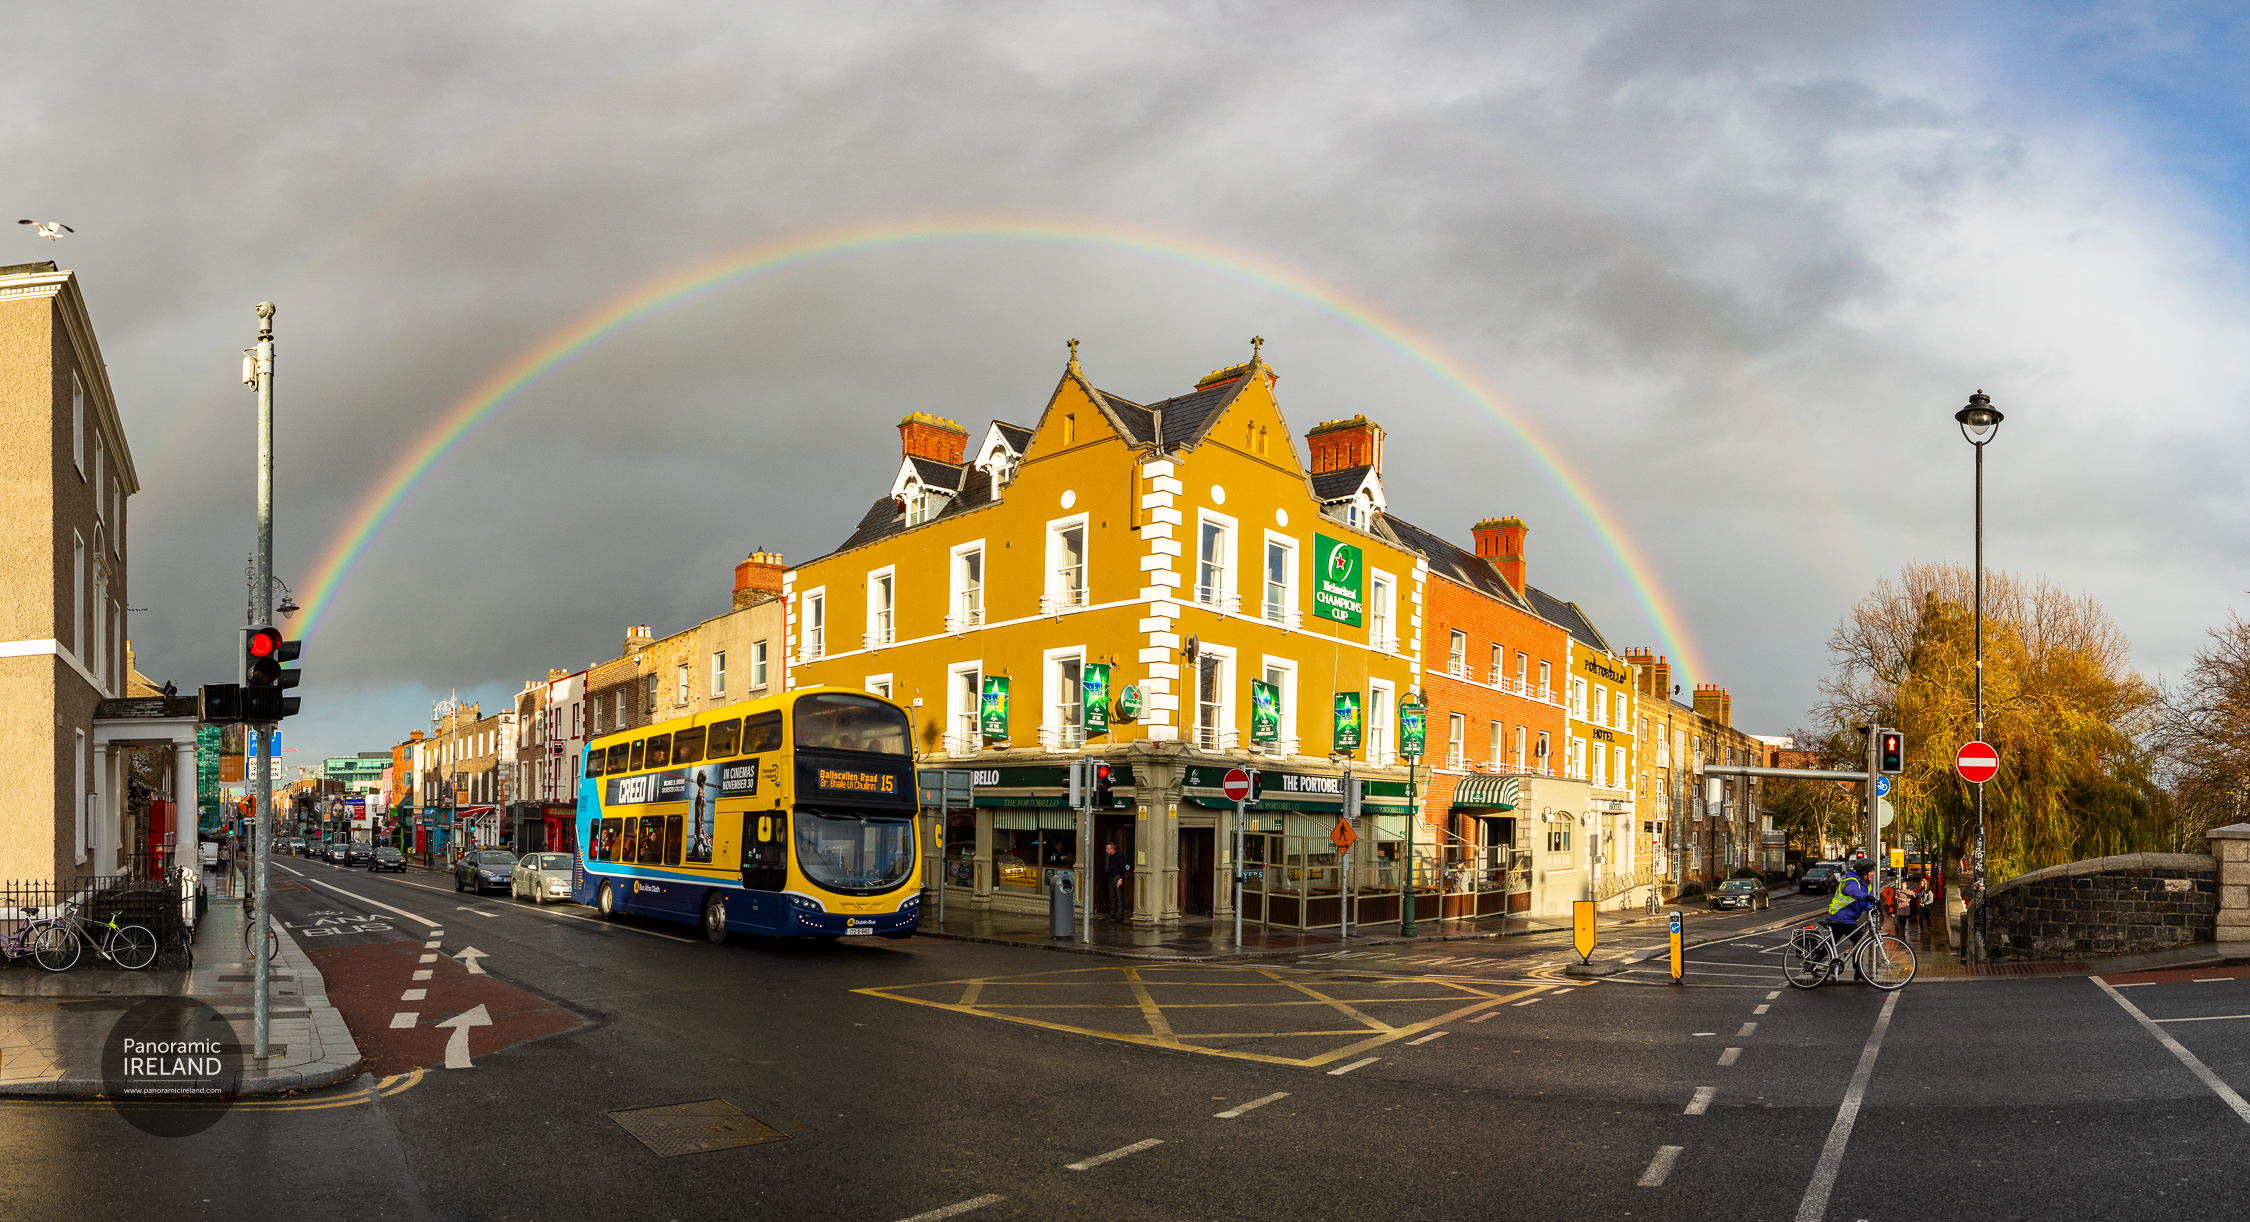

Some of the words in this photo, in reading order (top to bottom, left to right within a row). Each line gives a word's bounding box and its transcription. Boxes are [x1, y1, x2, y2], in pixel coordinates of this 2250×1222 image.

[1323, 580, 1356, 600] Heineken
[1316, 591, 1362, 614] CHAMPIONS
[1331, 608, 1348, 621] CUP
[1584, 659, 1625, 685] PORTOBELLO
[1592, 727, 1615, 743] HOTEL
[723, 768, 730, 780] IN
[730, 765, 755, 779] CINEMAS
[860, 773, 878, 783] Road
[618, 776, 646, 804] CREED
[647, 774, 656, 802] II
[722, 779, 746, 790] NOVEMBER
[747, 778, 754, 789] 30
[880, 774, 894, 792] 15
[1282, 774, 1298, 791] THE
[1003, 799, 1016, 807] THE
[1017, 799, 1059, 808] PORTOBELLO
[1265, 802, 1300, 810] PORTOBELLO
[1379, 806, 1405, 814] PORTOBELLO
[1003, 867, 1037, 880] SHELL
[284, 914, 395, 928] LANA
[302, 922, 393, 937] BUS
